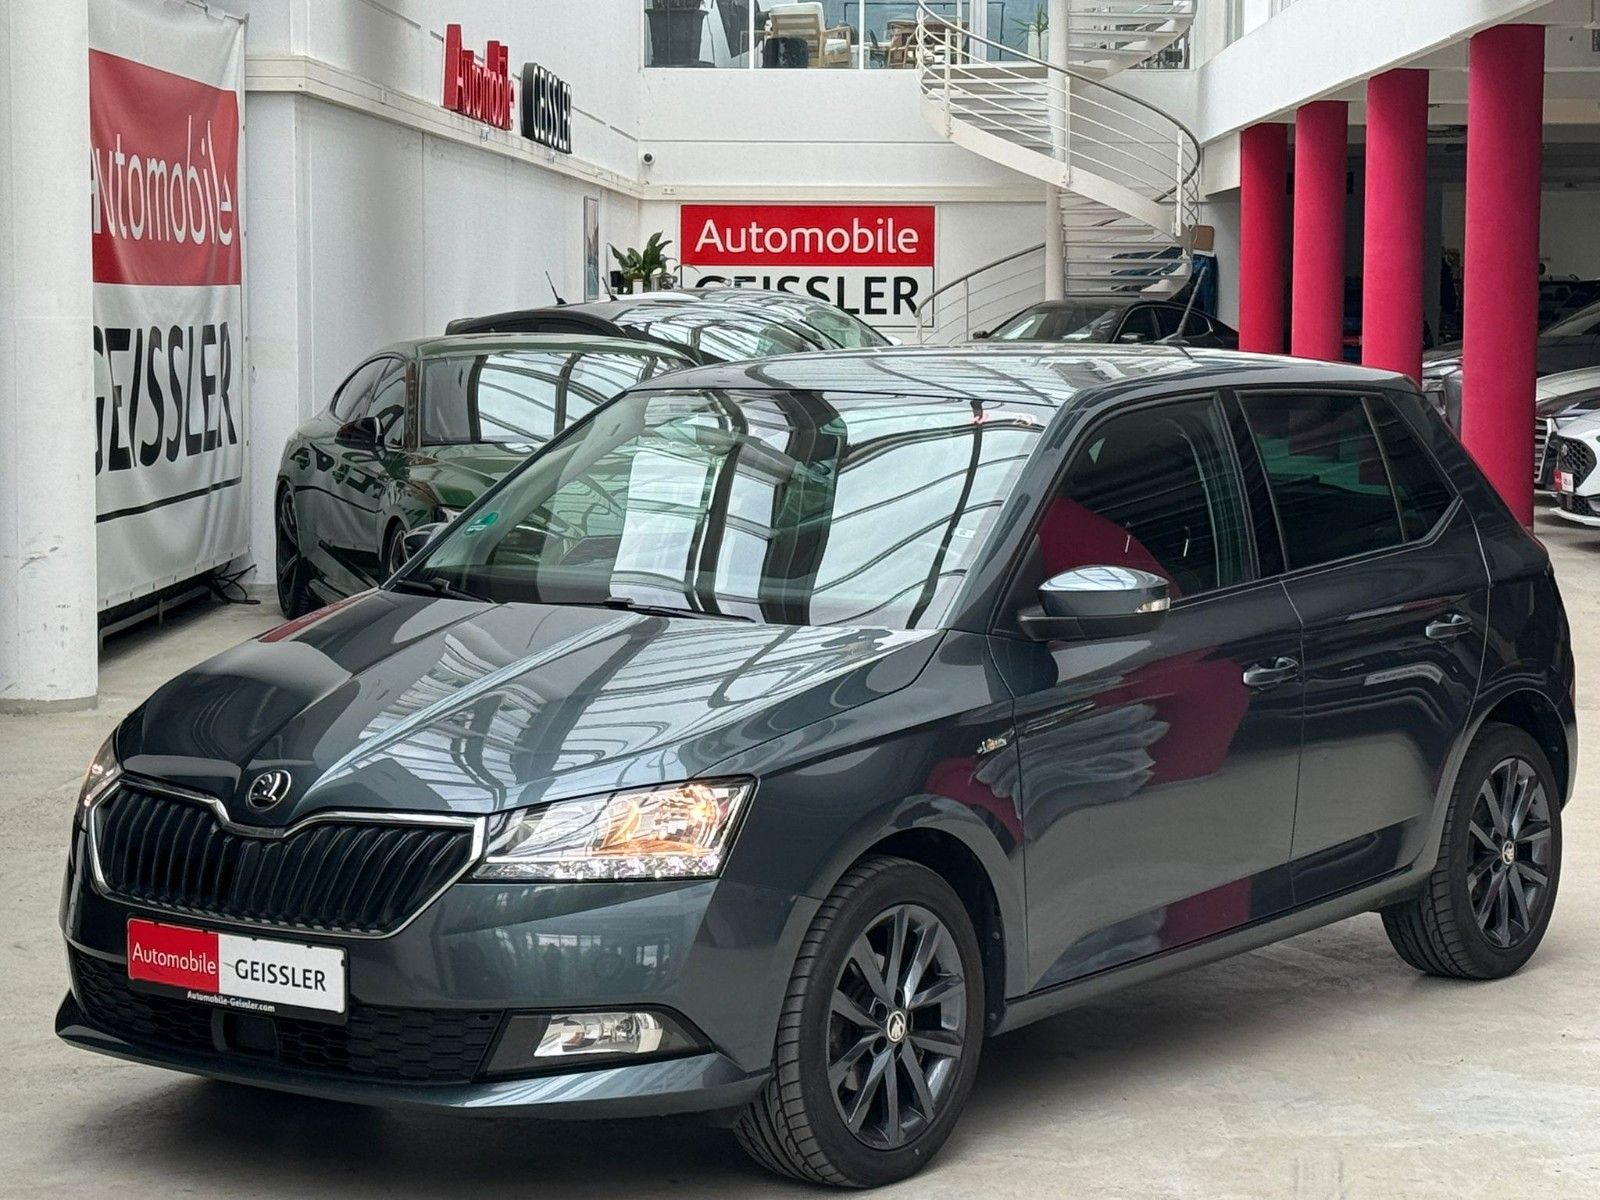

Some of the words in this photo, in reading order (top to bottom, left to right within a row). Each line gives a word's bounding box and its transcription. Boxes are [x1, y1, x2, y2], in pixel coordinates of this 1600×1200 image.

[694, 217, 919, 254] Automobile
[132, 943, 217, 975] Automobile
[235, 959, 326, 992] GEISSLER
[187, 990, 275, 1012] Automobile-Geissler.com
